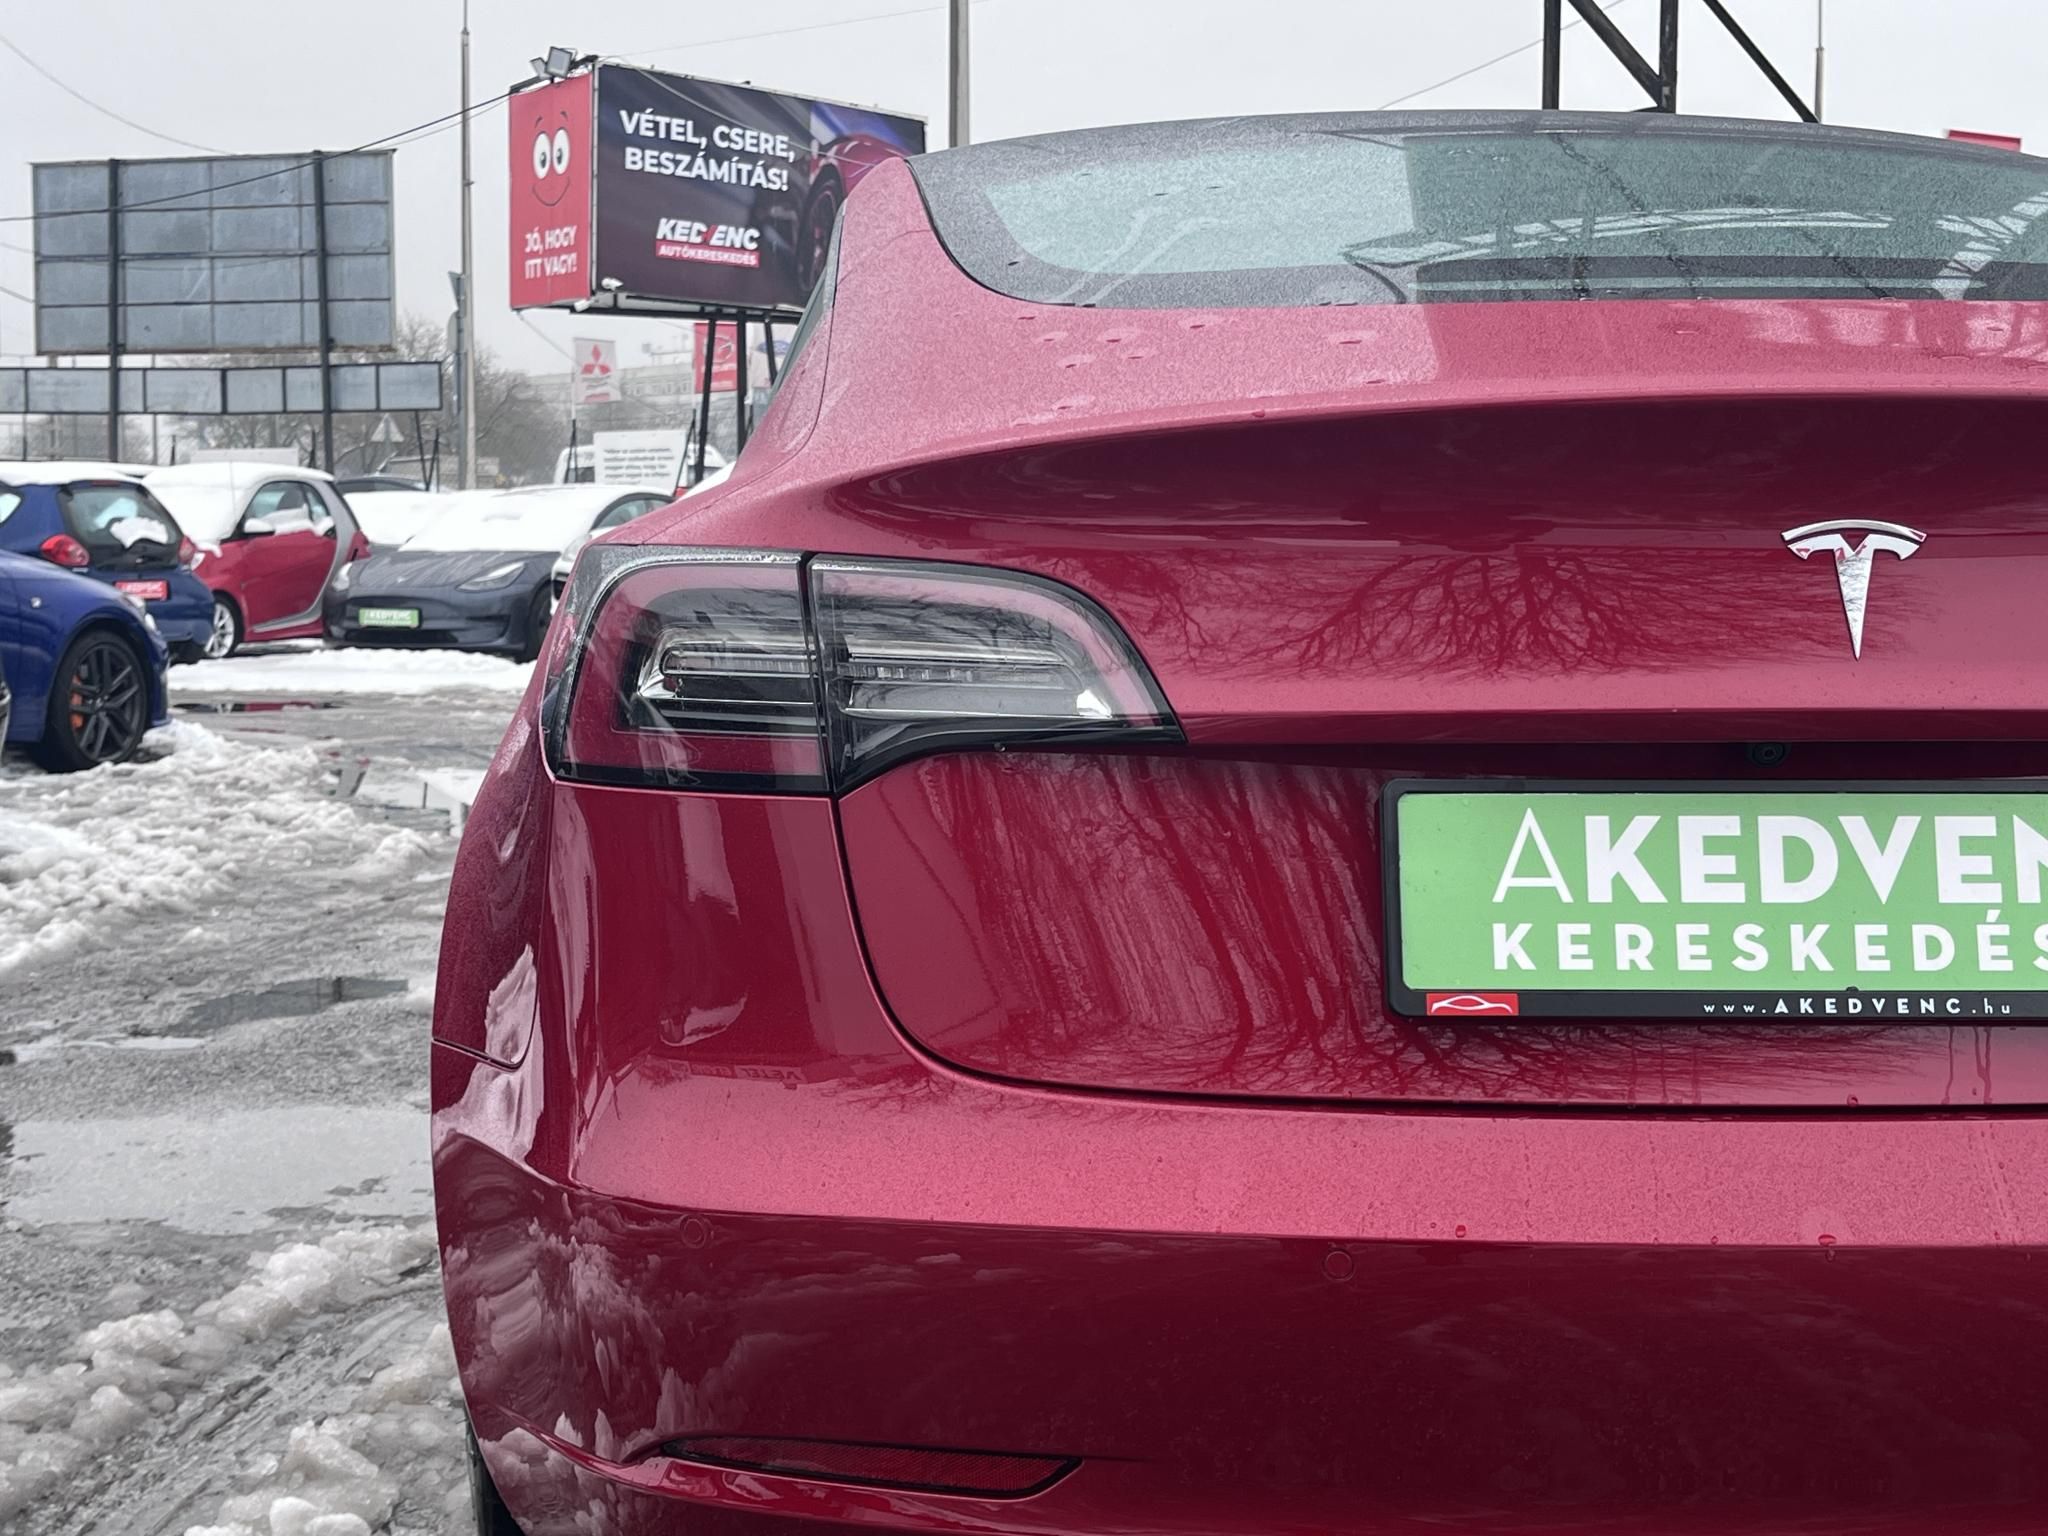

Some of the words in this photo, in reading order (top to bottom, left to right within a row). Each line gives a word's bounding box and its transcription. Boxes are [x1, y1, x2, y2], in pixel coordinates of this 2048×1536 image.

[619, 108, 707, 149] VÉTEL,
[713, 125, 795, 163] CSERE,
[625, 151, 789, 192] BESZÁMÍTÁS!
[525, 226, 544, 255] JÓ,
[544, 225, 577, 250] HOGY
[525, 258, 543, 279] ITT
[543, 252, 577, 276] VAGY!
[1703, 998, 2011, 1015] www.AKEDVENC.hu
